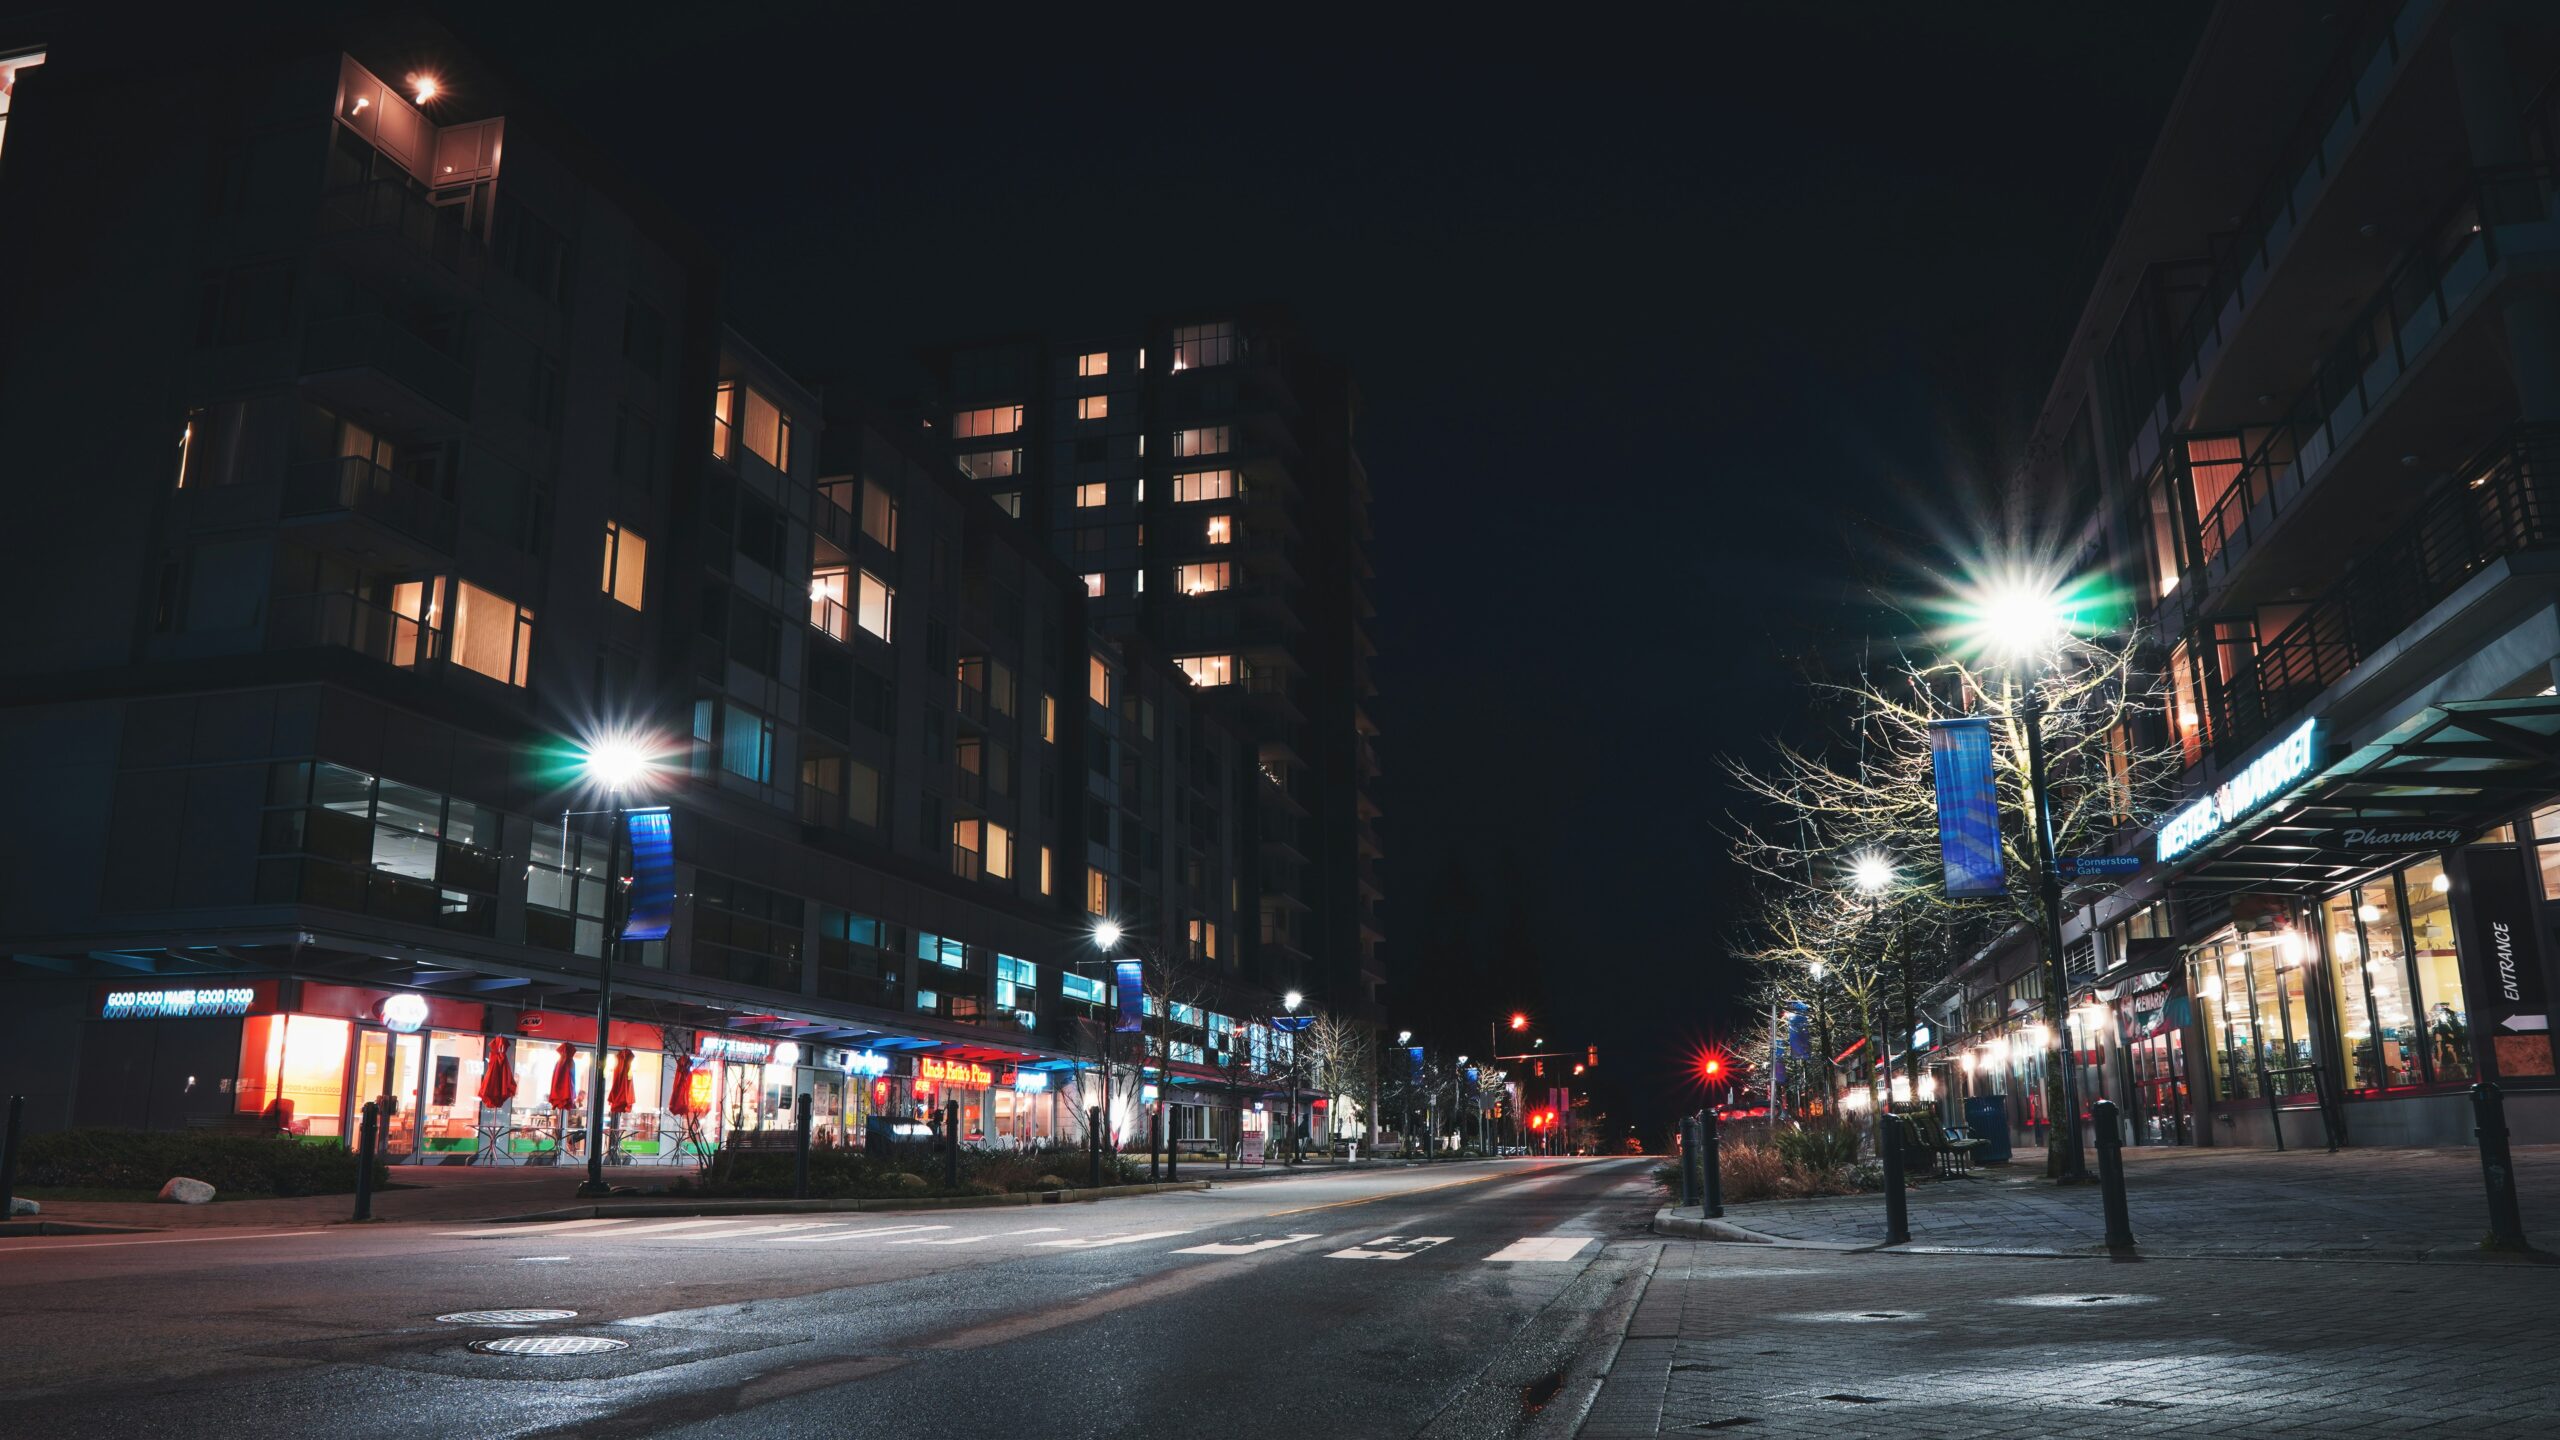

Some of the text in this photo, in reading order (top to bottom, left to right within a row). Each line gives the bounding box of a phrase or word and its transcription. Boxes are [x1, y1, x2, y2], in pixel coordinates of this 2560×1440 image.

[2232, 715, 2317, 819] MARKET
[2342, 826, 2462, 849] Pharmacy
[2076, 856, 2140, 867] Cornerstone
[2077, 866, 2102, 876] Gate
[2492, 921, 2521, 1001] ENTRANCE
[107, 988, 254, 1007] GOOD FOOD MAKES GOOD FOOD
[923, 1058, 945, 1079] Uncle
[971, 1063, 991, 1083] Pizza
